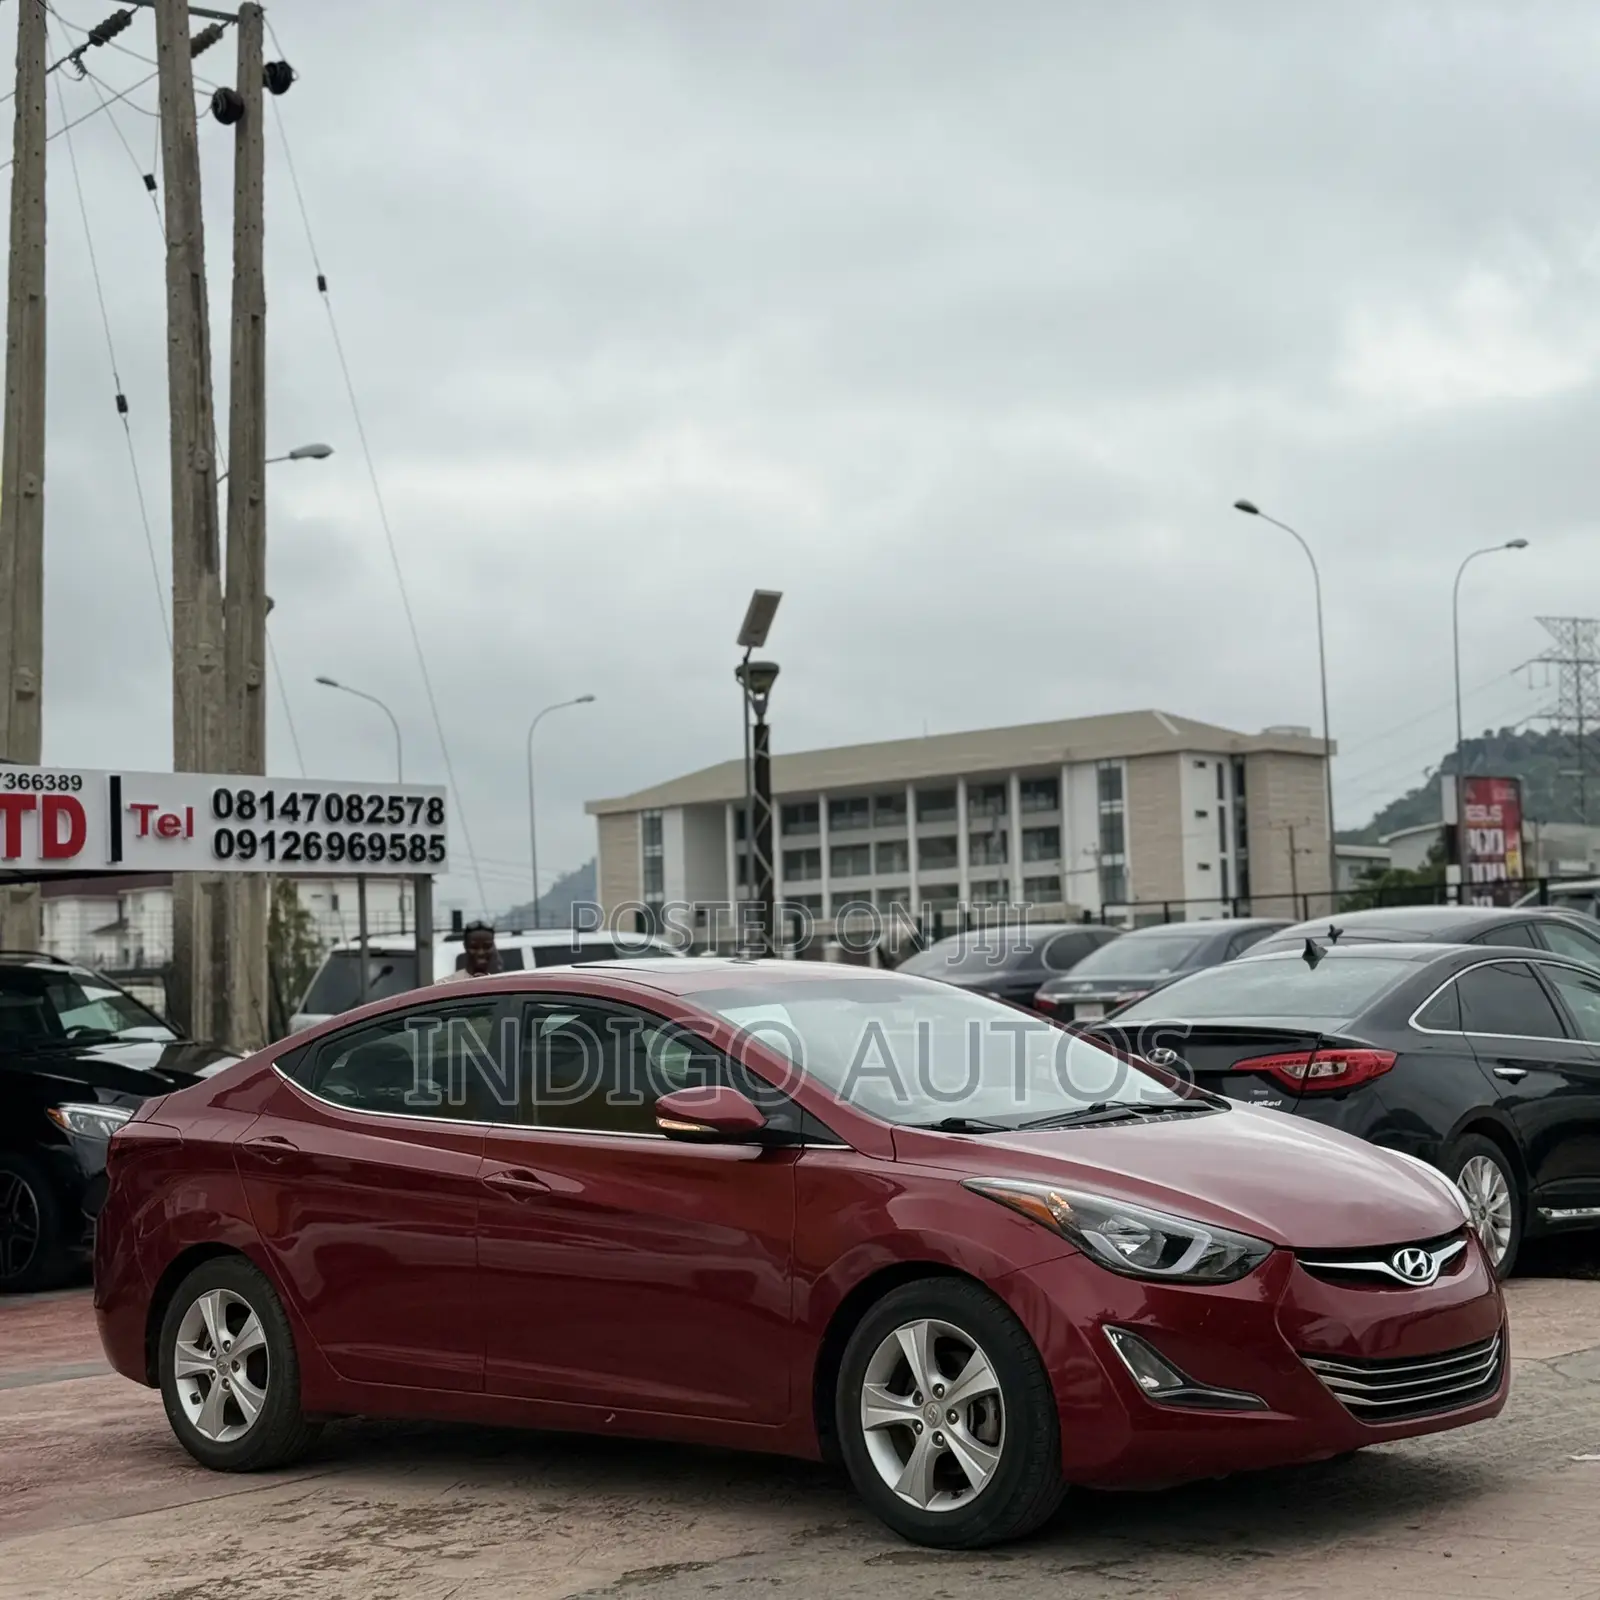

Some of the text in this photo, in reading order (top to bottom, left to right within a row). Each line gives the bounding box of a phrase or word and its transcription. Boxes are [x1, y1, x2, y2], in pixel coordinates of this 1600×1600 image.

[0, 772, 83, 791] 366389
[130, 803, 194, 838] Tel
[212, 788, 445, 825] 08147082578
[213, 828, 446, 862] 09126969585
